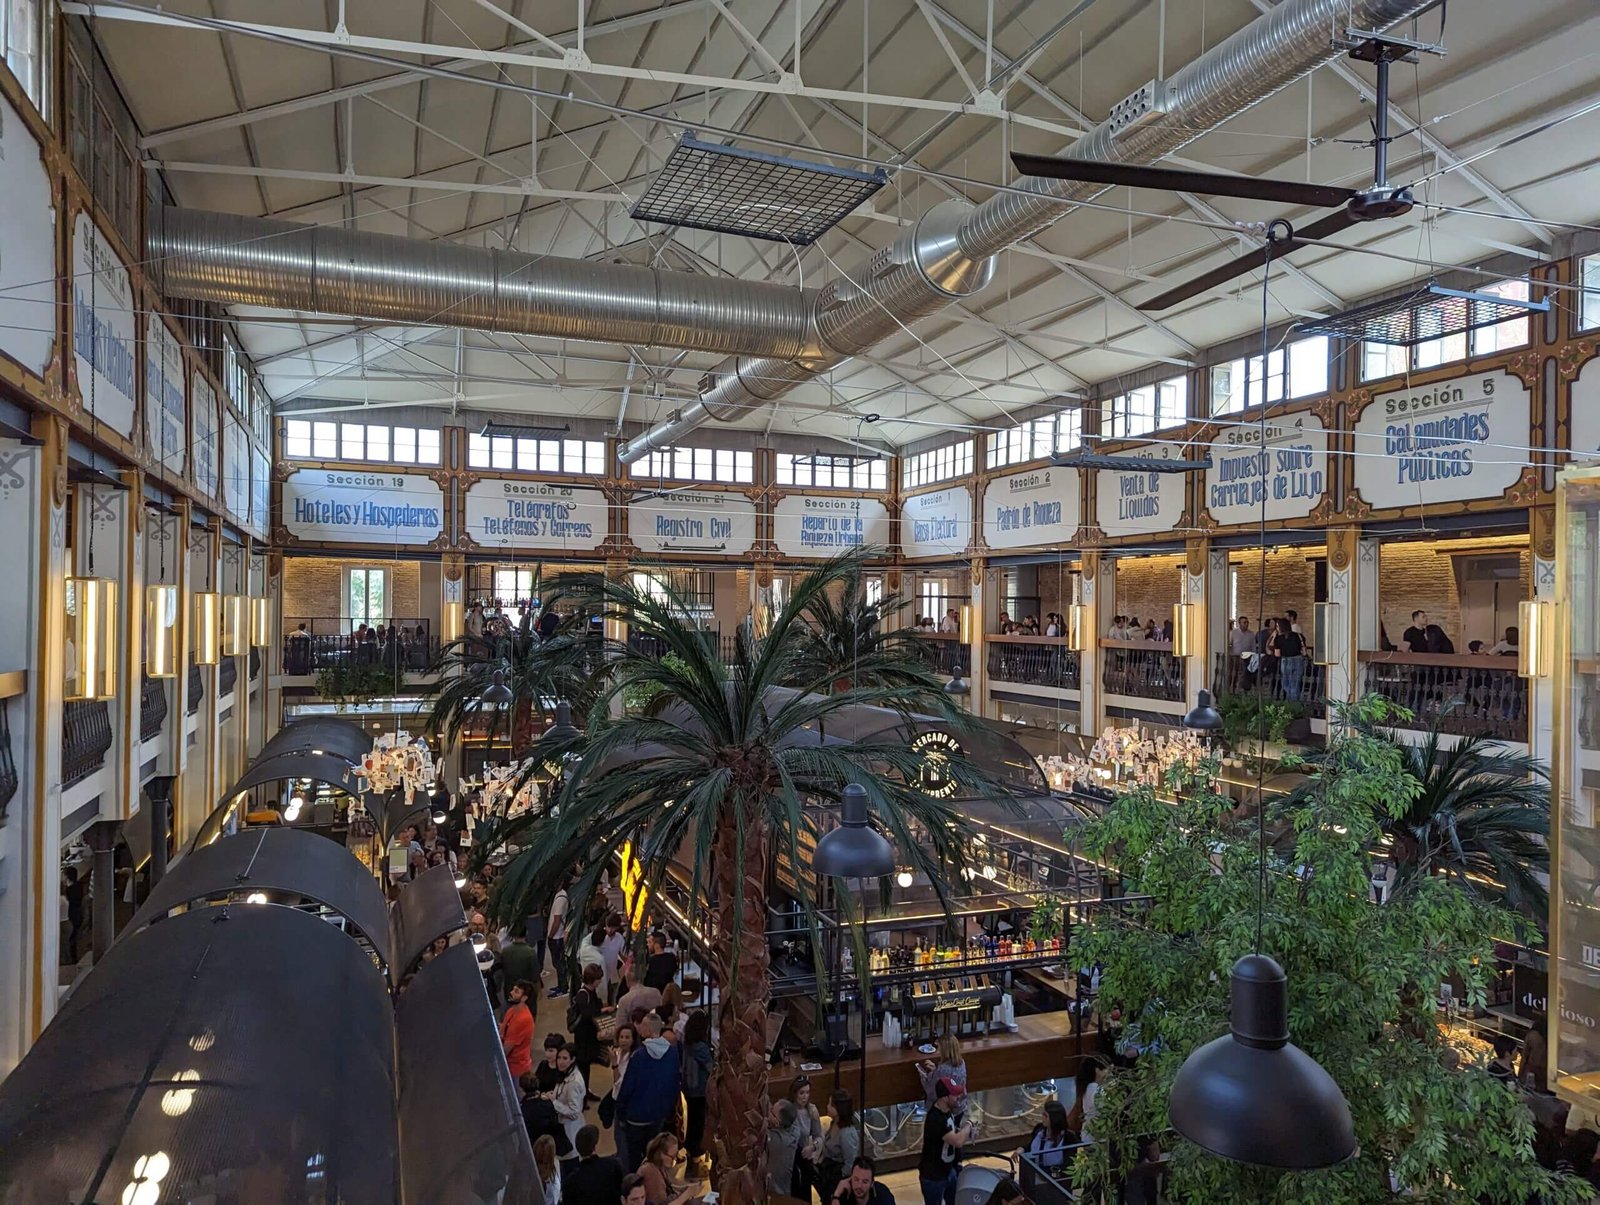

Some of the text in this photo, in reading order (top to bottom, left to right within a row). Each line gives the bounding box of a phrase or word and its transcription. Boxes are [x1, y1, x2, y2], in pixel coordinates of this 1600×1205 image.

[1385, 378, 1495, 415] Sección 5
[1227, 417, 1303, 445] Seccón 4
[1385, 411, 1490, 456] Calamidades
[1162, 446, 1169, 459] 3
[1219, 450, 1270, 482] Impuesto
[326, 473, 404, 488] Sección 19
[503, 483, 573, 496] Sección 20
[1009, 471, 1051, 489] Sección 2
[1119, 471, 1160, 498] Venta de
[1273, 474, 1288, 500] de
[1290, 470, 1323, 500] Lujo
[295, 497, 350, 525] Hoteles
[353, 504, 361, 526] y
[506, 499, 570, 521] Telégrafos
[804, 498, 861, 510] Sección 22
[1023, 502, 1031, 528] de
[1118, 494, 1160, 520] Líquidos
[540, 520, 547, 537] y
[550, 519, 593, 539] Correos
[656, 515, 732, 541] Registro Civil
[911, 732, 960, 753] MERCADO DE
